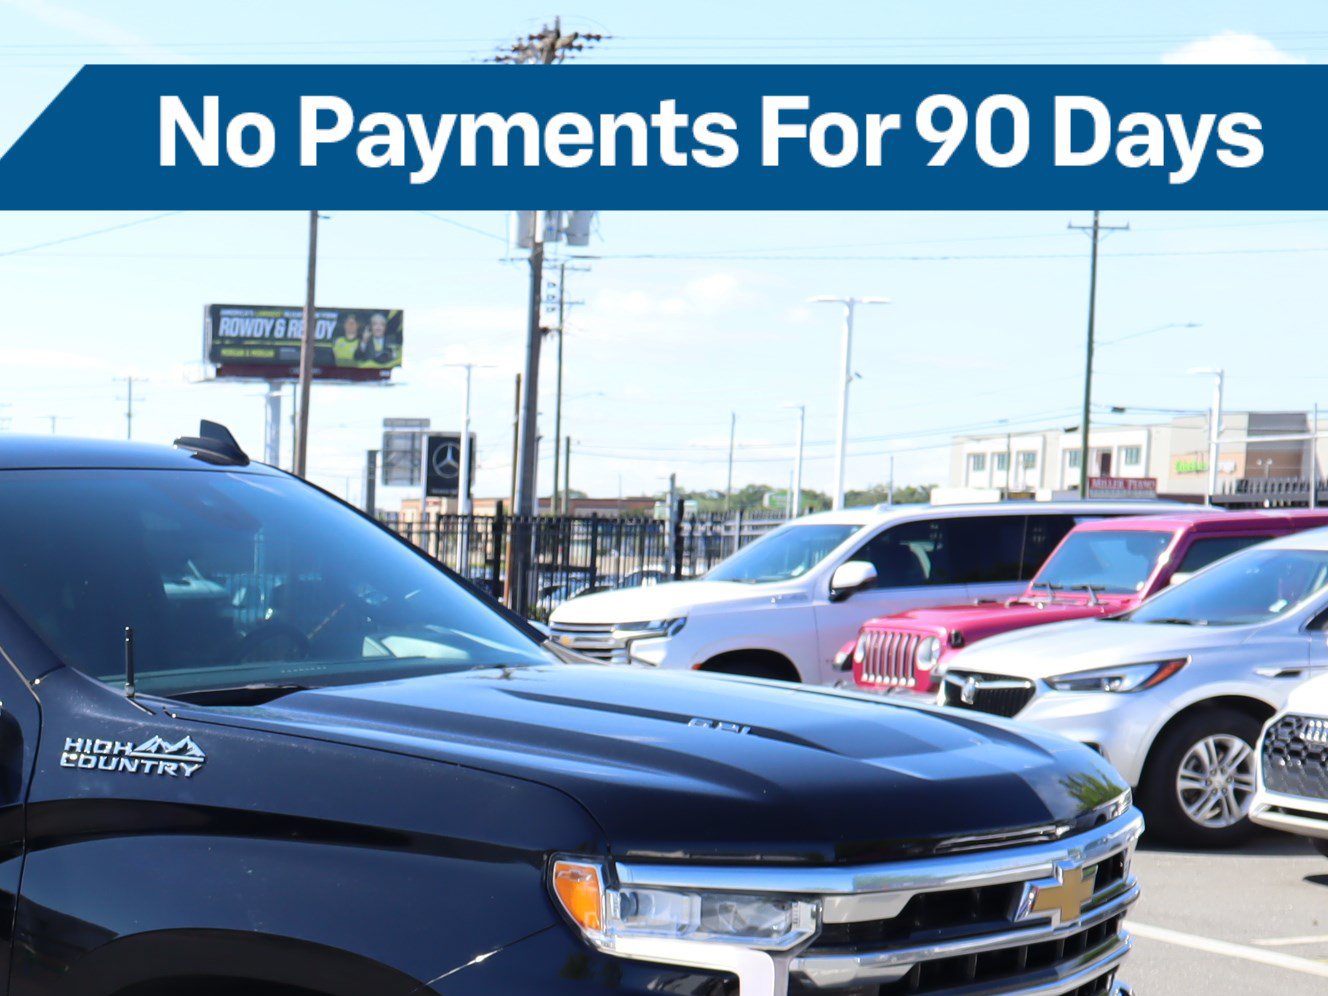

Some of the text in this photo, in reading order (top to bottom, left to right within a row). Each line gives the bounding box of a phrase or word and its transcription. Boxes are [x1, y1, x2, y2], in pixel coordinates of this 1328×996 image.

[219, 317, 272, 338] ROWDY
[286, 319, 338, 340] REDY
[63, 736, 132, 756] HIGH
[60, 751, 203, 777] COUNTRY
